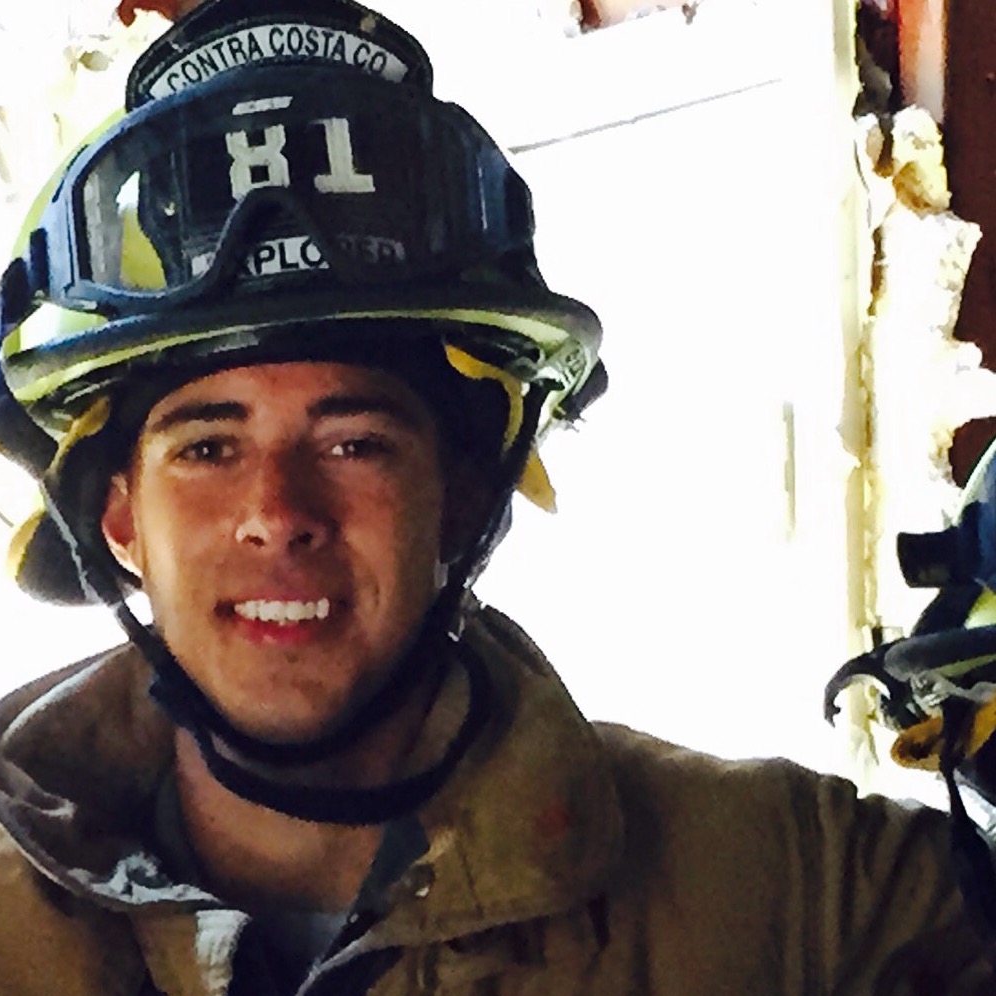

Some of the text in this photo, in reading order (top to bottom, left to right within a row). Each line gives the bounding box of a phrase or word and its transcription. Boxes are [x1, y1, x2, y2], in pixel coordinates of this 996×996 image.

[166, 26, 387, 93] CONTRA COSTA CO
[225, 117, 376, 201] 81
